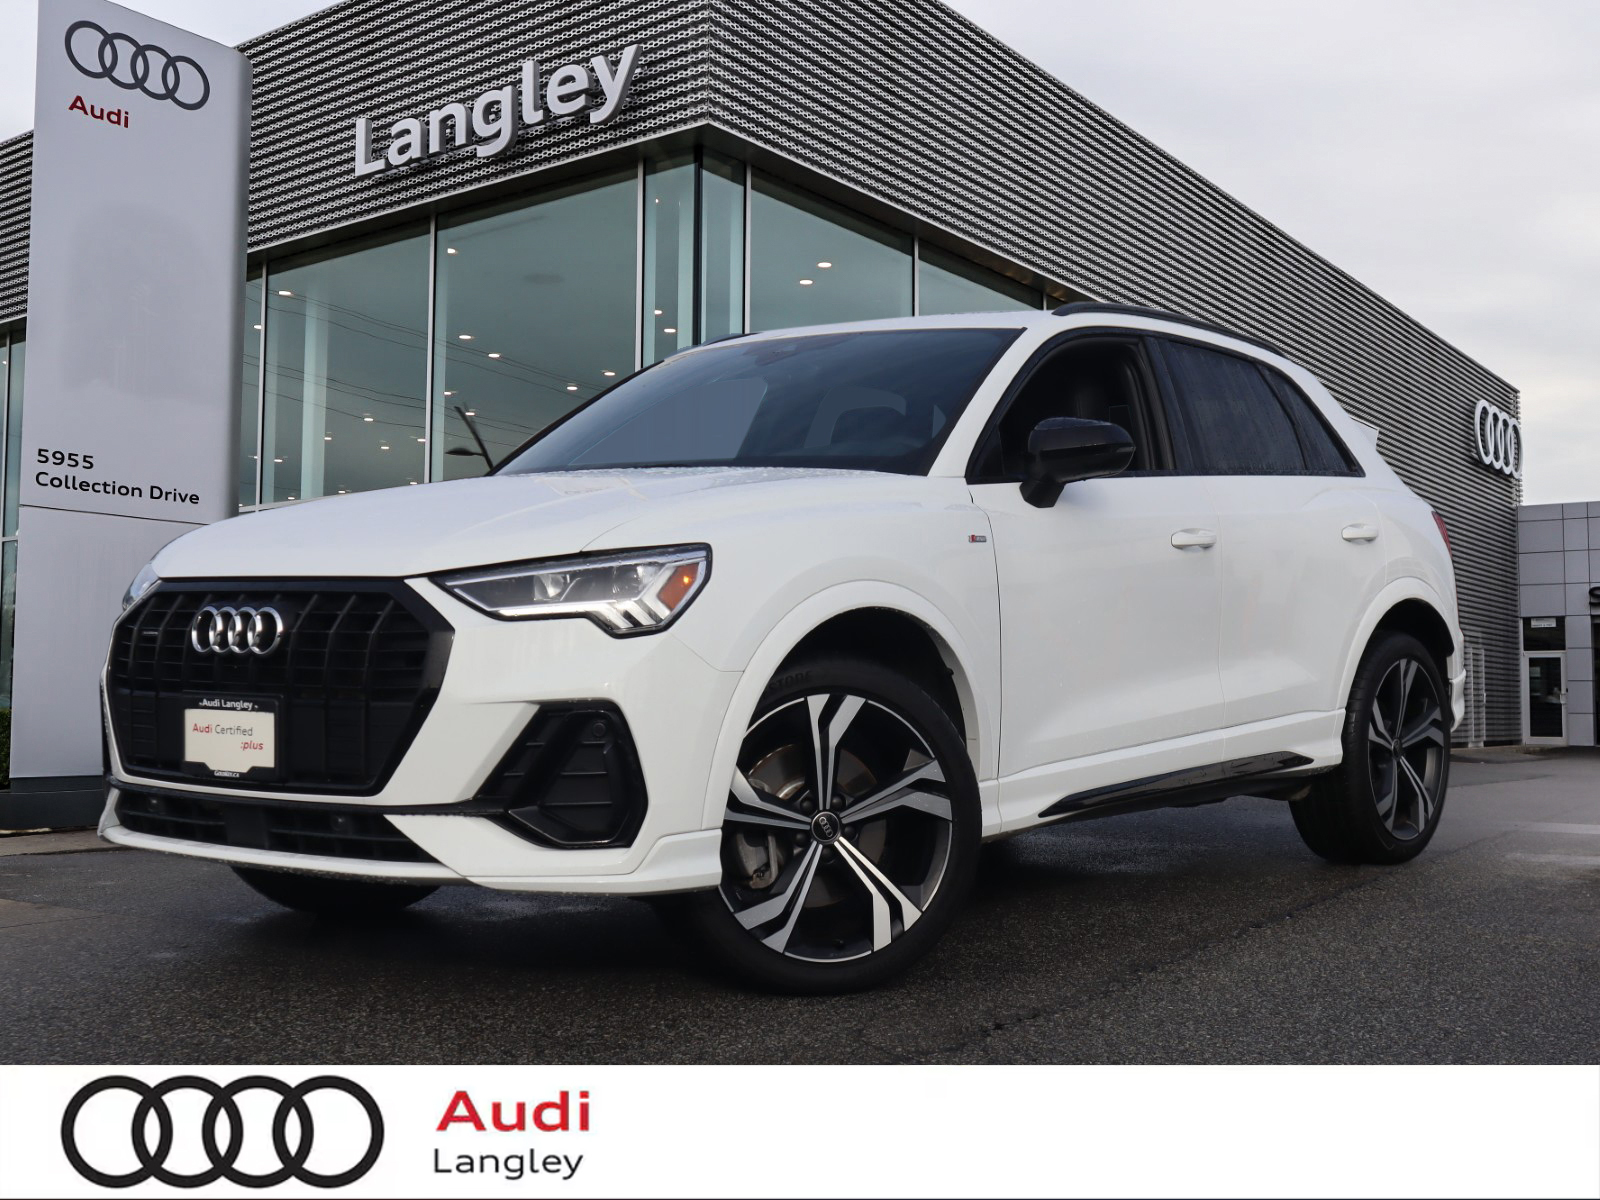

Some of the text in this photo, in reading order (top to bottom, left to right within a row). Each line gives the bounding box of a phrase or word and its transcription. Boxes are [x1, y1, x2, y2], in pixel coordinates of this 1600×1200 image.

[68, 95, 129, 128] Audi
[355, 44, 643, 177] Langley
[37, 448, 94, 470] 5955
[35, 471, 200, 504] Collection Drive
[202, 698, 253, 710] Audi Langley
[192, 723, 254, 737] Audi Certified
